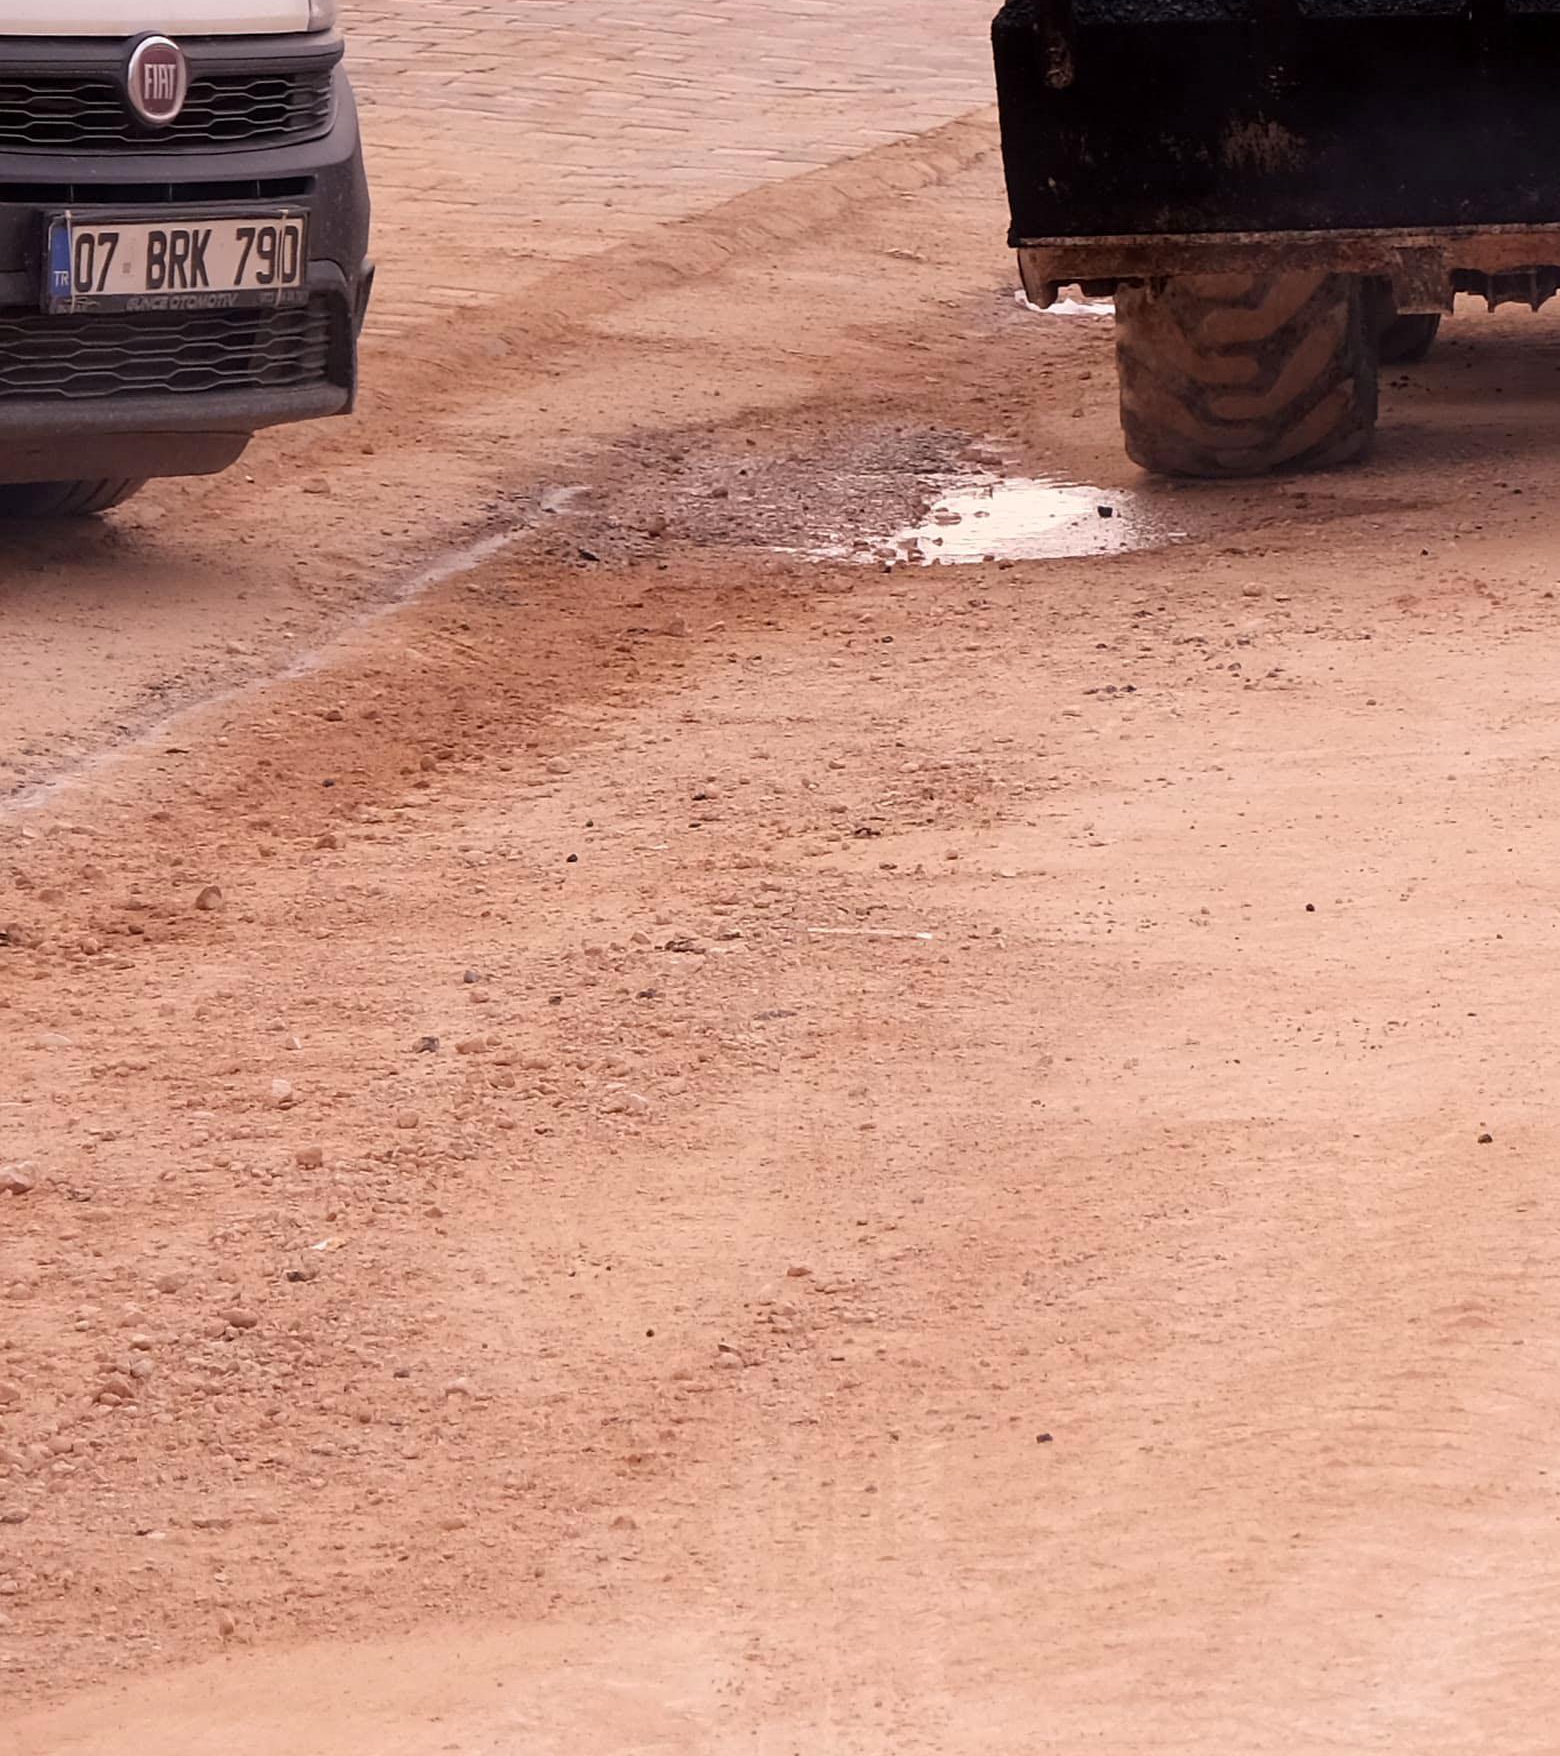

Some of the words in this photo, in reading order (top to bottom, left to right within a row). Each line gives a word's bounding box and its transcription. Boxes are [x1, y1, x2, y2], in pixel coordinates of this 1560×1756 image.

[144, 63, 176, 100] FIAT
[74, 232, 120, 293] 07
[146, 229, 212, 291] BRK
[233, 225, 300, 286] 790
[53, 270, 70, 286] TR
